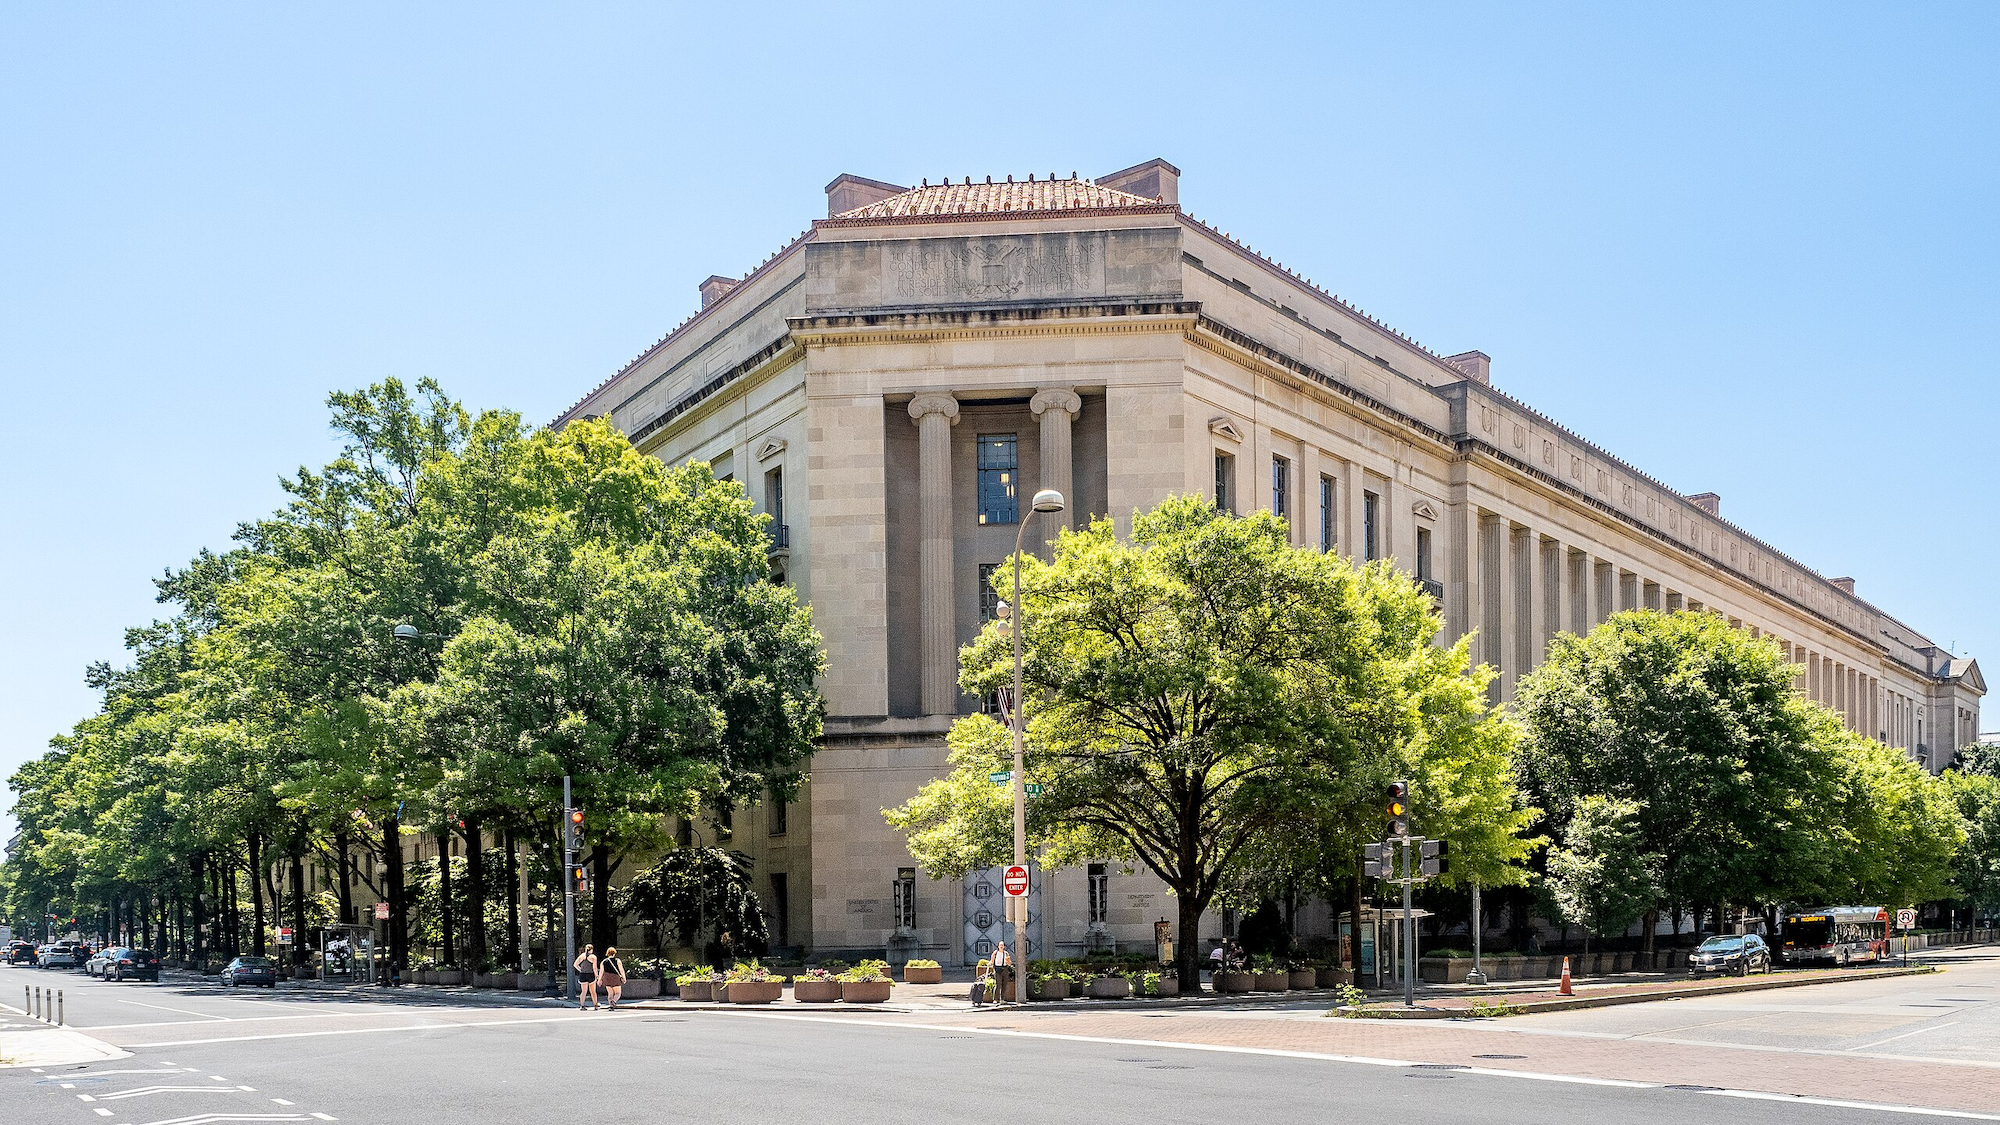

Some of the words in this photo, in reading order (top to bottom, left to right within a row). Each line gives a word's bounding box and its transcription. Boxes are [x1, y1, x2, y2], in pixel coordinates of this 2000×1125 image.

[891, 251, 940, 261] JUSTICE
[1050, 246, 1070, 256] LIFE
[1074, 245, 1096, 255] AND
[890, 260, 941, 271] CONDUCT
[945, 259, 960, 270] OF
[1051, 254, 1081, 265] STATE
[898, 269, 960, 281] POSSIBLE
[1050, 264, 1062, 273] AS
[1065, 262, 1090, 273] FIRST
[895, 288, 915, 297] AND
[919, 287, 948, 297] SOULS
[1044, 282, 1090, 291] CITIZENS
[908, 278, 948, 289] RESIDES
